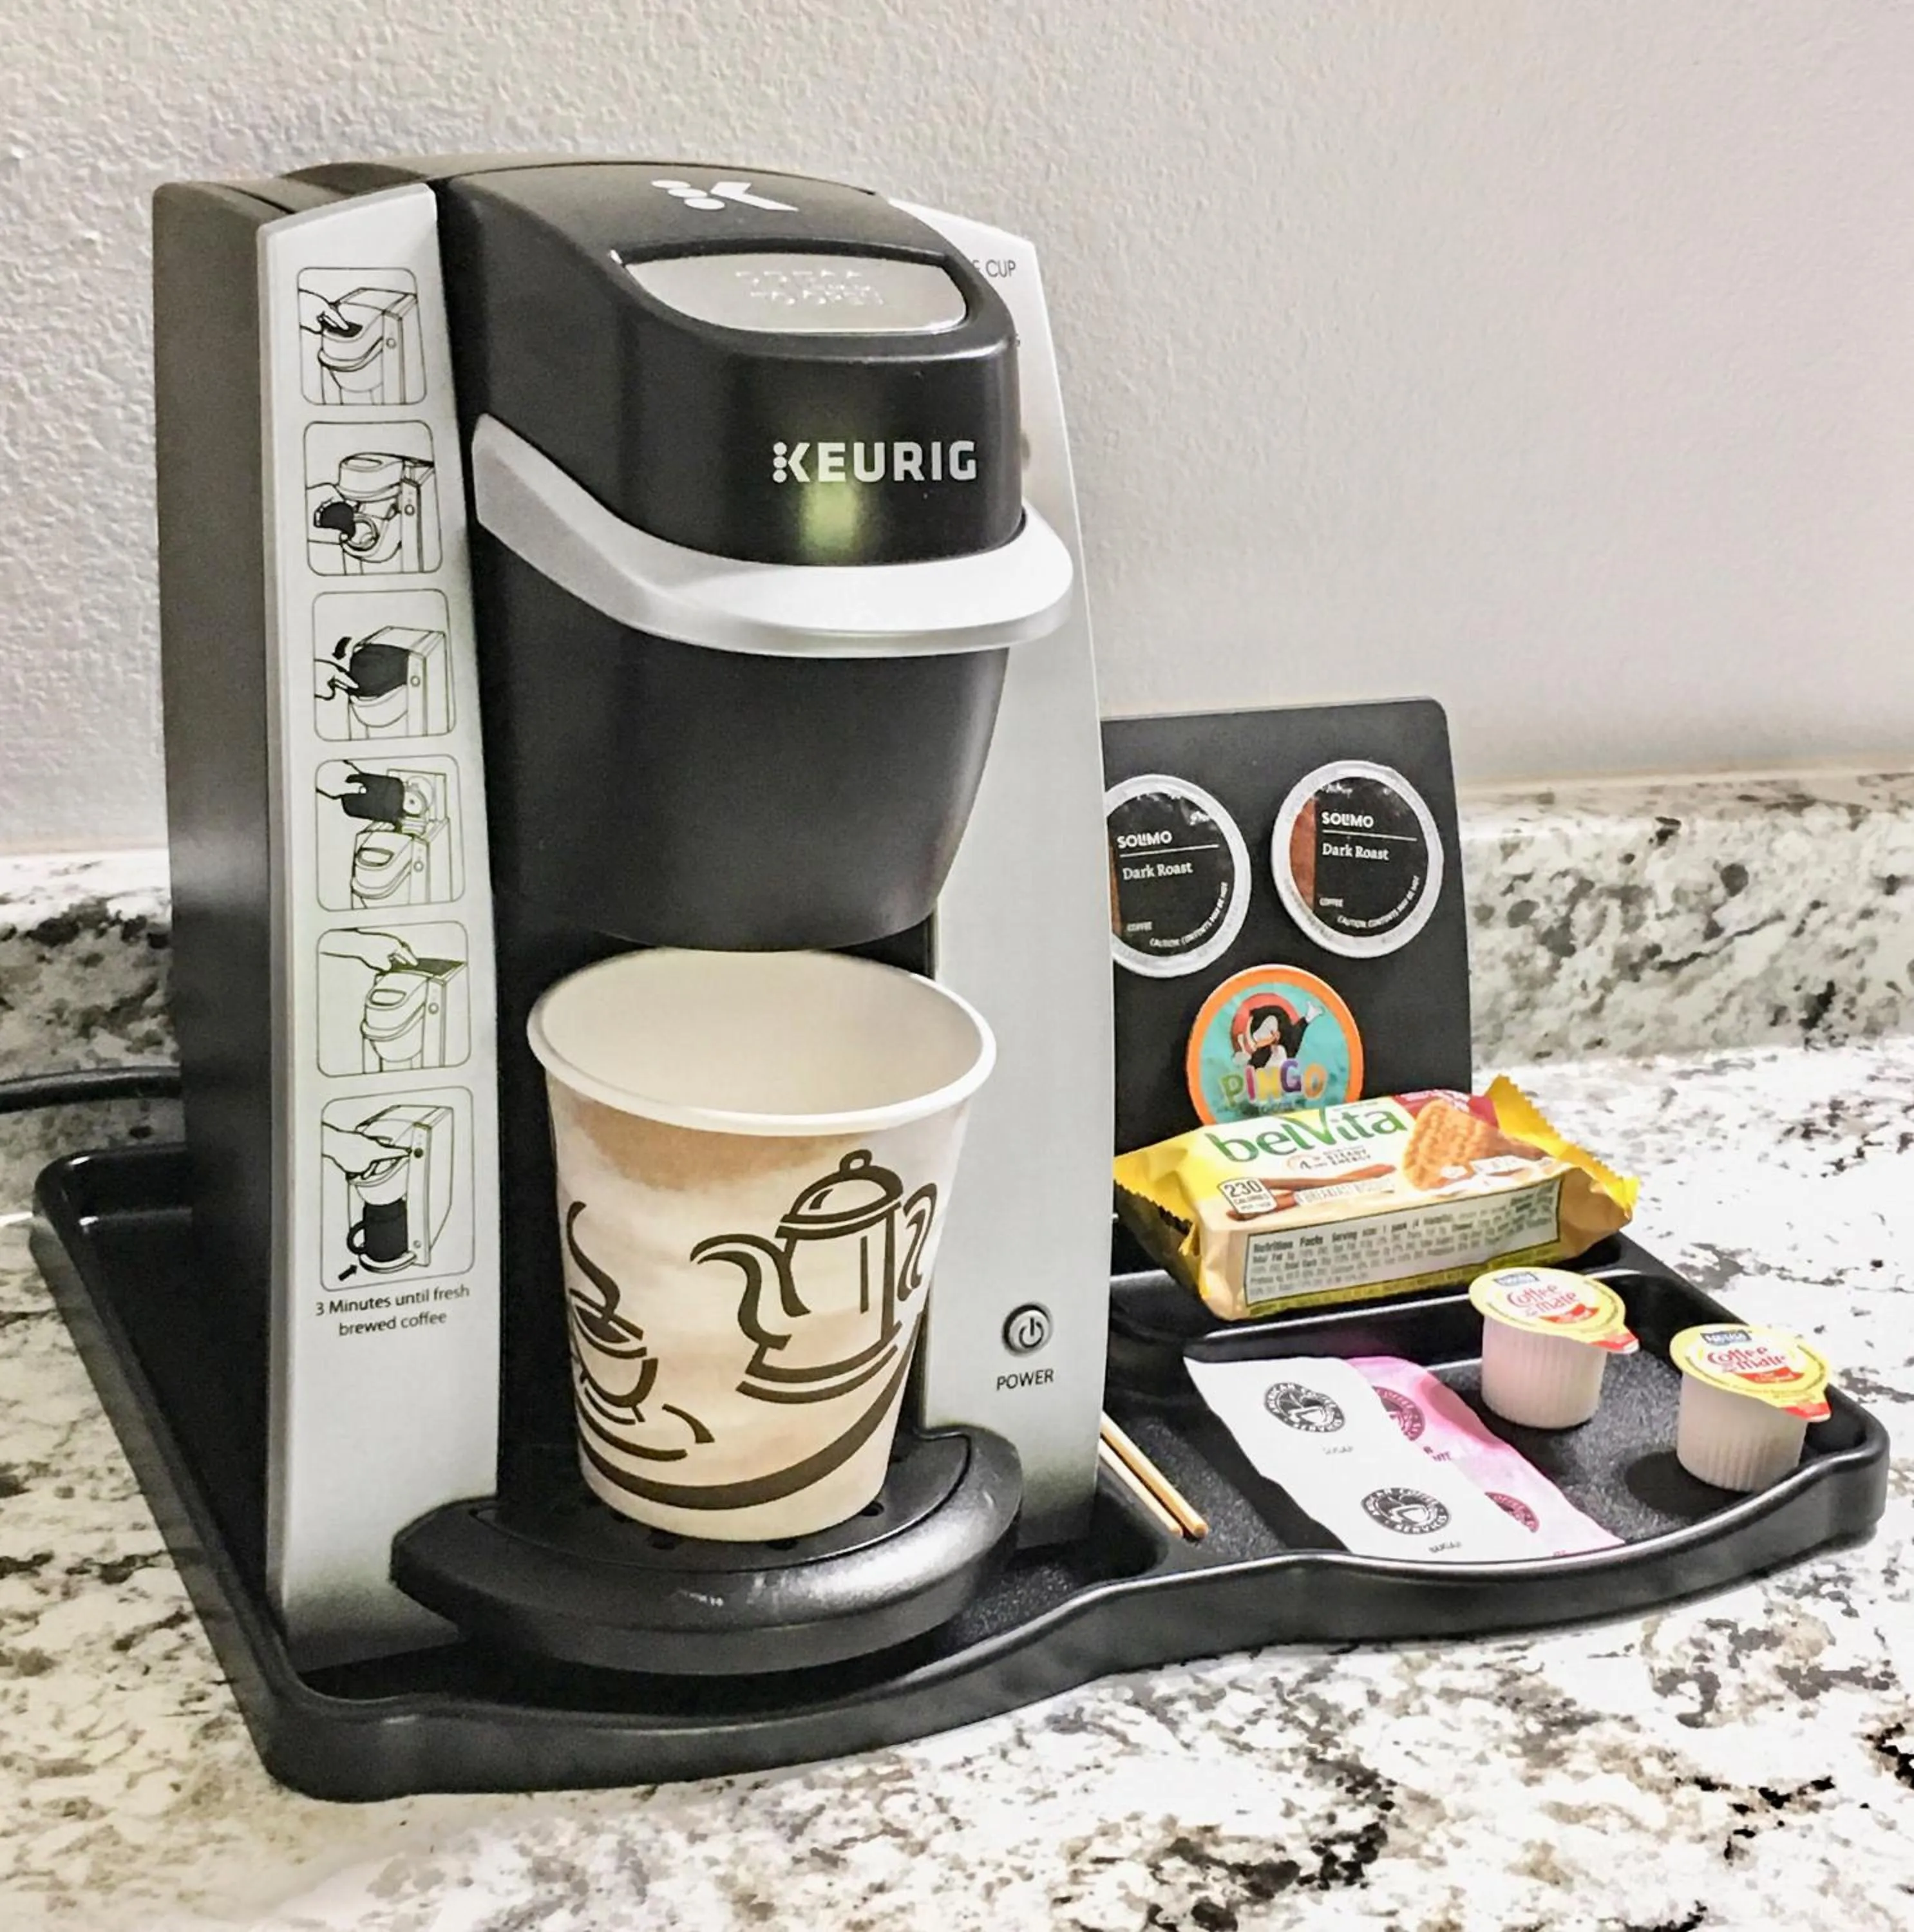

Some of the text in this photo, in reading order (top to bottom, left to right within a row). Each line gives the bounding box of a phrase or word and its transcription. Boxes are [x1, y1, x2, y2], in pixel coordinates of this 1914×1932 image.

[985, 260, 1016, 278] CUP
[773, 440, 977, 483] KEURIG
[1322, 811, 1374, 828] SOLIMO
[1117, 831, 1172, 849] SOLIMO
[1322, 842, 1389, 861] Dark Roast
[1123, 863, 1193, 880] Dark Roast
[1220, 1059, 1328, 1108] PINGO
[1205, 1106, 1408, 1162] belVita
[1224, 1180, 1262, 1198] 230
[316, 1284, 470, 1316] 3 Minutes until fresh
[1506, 1284, 1559, 1307] Coffee
[339, 1311, 447, 1336] brewed coffee
[1707, 1346, 1768, 1365] Coffee
[996, 1368, 1054, 1391] POWER
